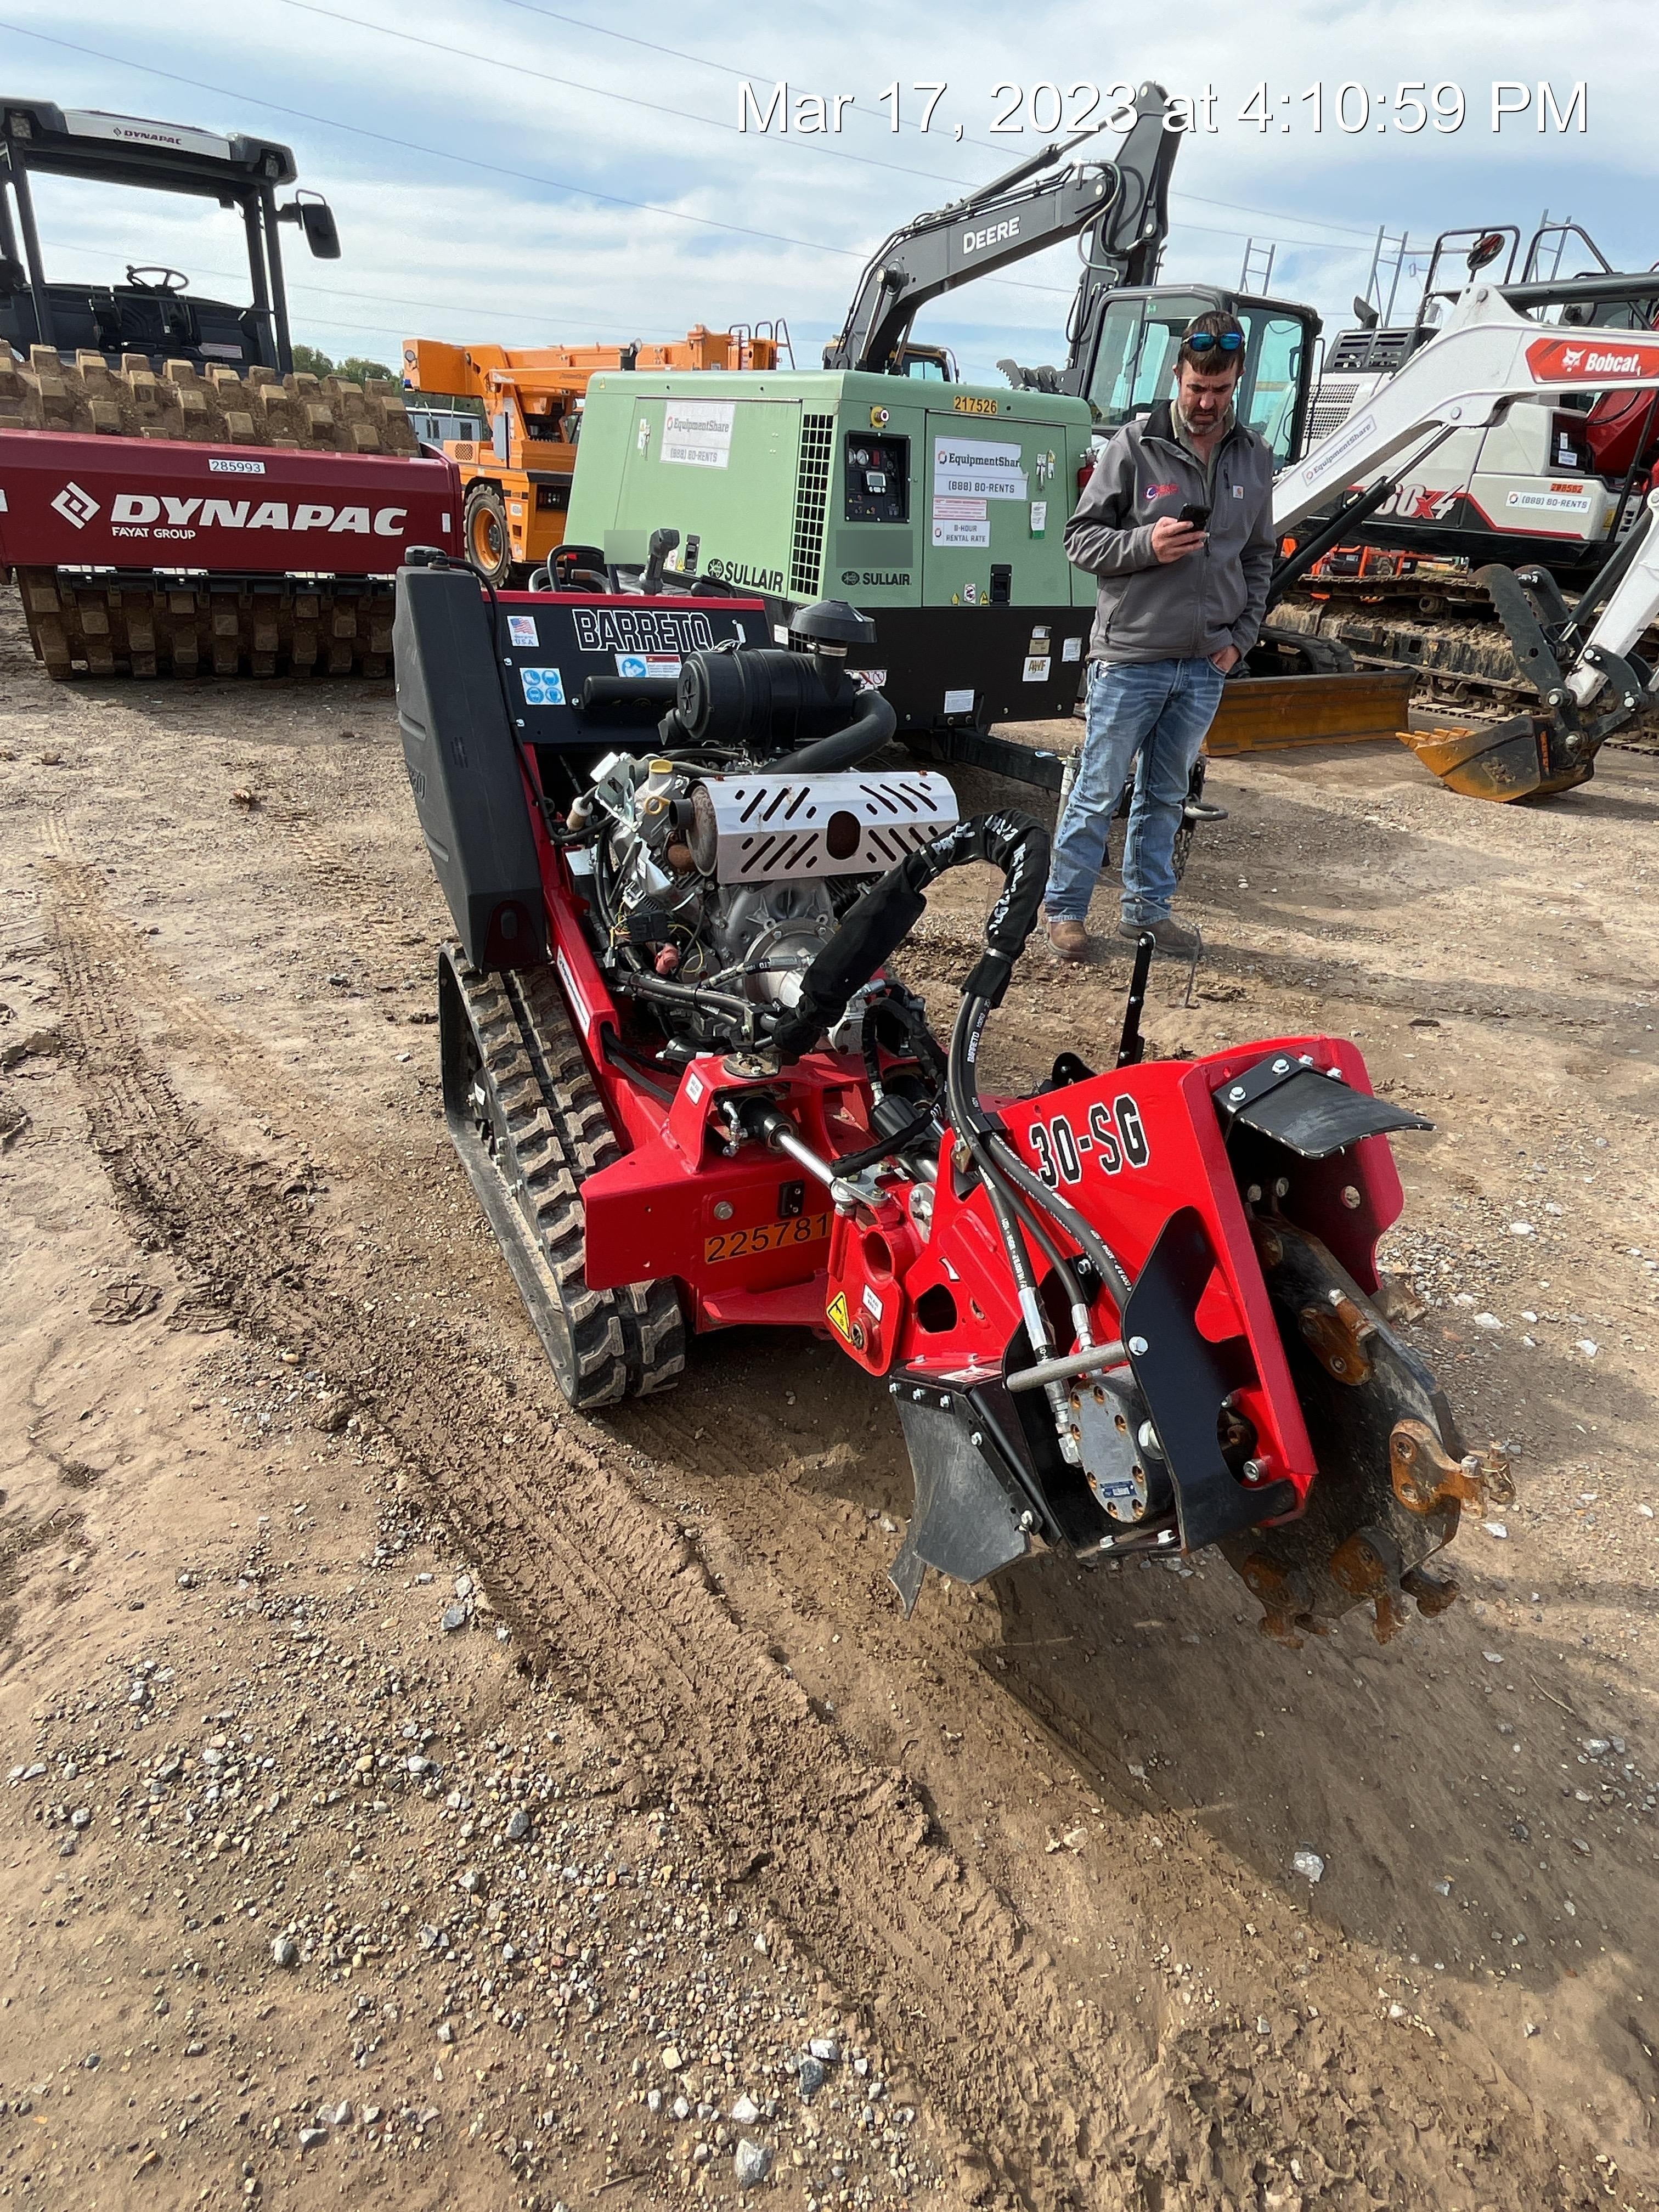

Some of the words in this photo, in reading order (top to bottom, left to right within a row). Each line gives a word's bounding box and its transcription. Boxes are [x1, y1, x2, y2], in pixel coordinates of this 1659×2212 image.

[124, 129, 182, 145] DYNAPAC
[963, 216, 1020, 255] DEERE
[1584, 352, 1639, 373] Bobcat
[955, 396, 997, 414] 217526
[674, 417, 730, 432] EquipmentShare
[211, 461, 262, 473] 285993
[949, 452, 1020, 467] EquipmentShar
[948, 480, 972, 492] (888)
[974, 482, 1015, 493] 80-RENTS
[110, 494, 408, 536] DYNAPAC
[111, 527, 149, 538] FAYAT
[153, 528, 196, 540] GROUP
[724, 561, 784, 593] SULLAIR
[862, 572, 910, 586] SULLAIR
[572, 608, 714, 653] BARRETO
[1029, 1093, 1150, 1189] 30-SG
[707, 1212, 827, 1262] 225781
